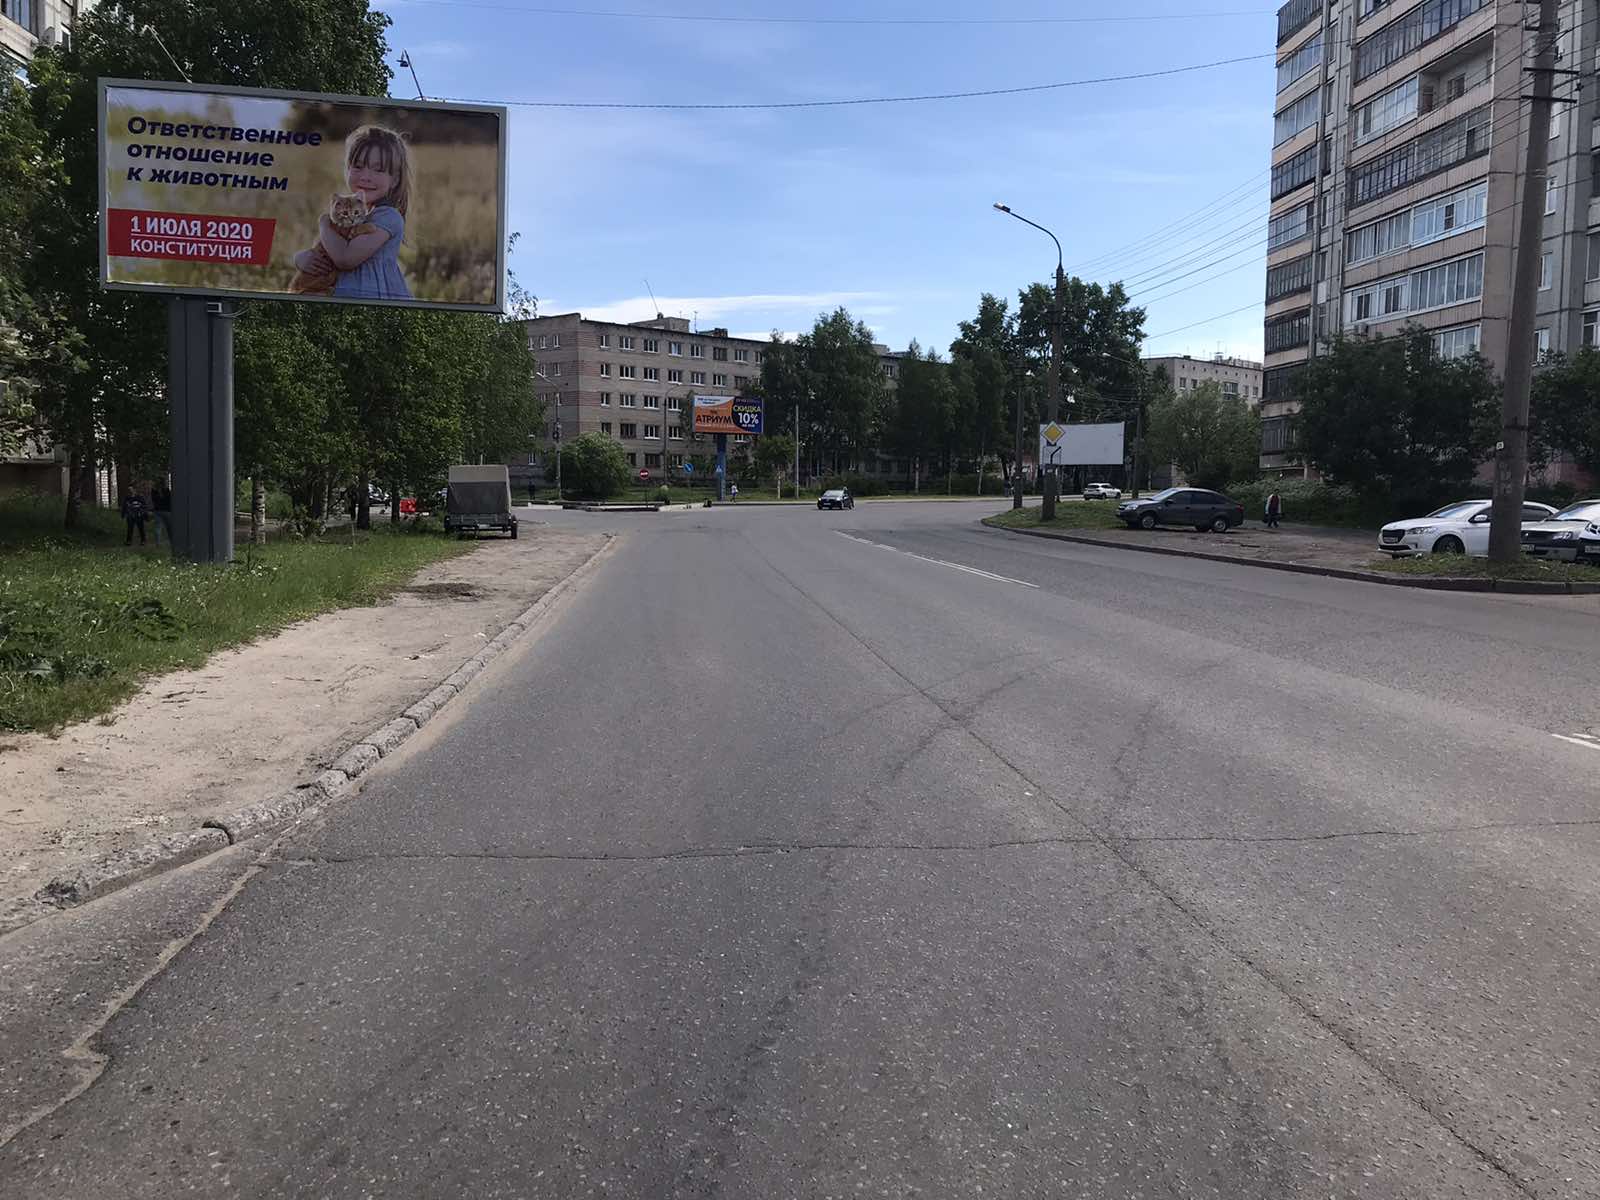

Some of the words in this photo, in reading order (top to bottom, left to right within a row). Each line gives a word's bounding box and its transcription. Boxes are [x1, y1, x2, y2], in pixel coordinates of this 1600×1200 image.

[127, 116, 323, 146] Ответственное
[127, 143, 274, 167] отношение
[127, 167, 144, 182] к
[149, 168, 289, 191] животным
[131, 216, 140, 233] 1
[146, 217, 201, 237] ИЮЛЯ
[207, 221, 253, 240] 2020
[131, 239, 252, 260] КОНСТИТУЦИЯ
[696, 414, 732, 424] АТРИУМ
[733, 405, 761, 413] СКИДКА
[738, 413, 759, 424] 10%
